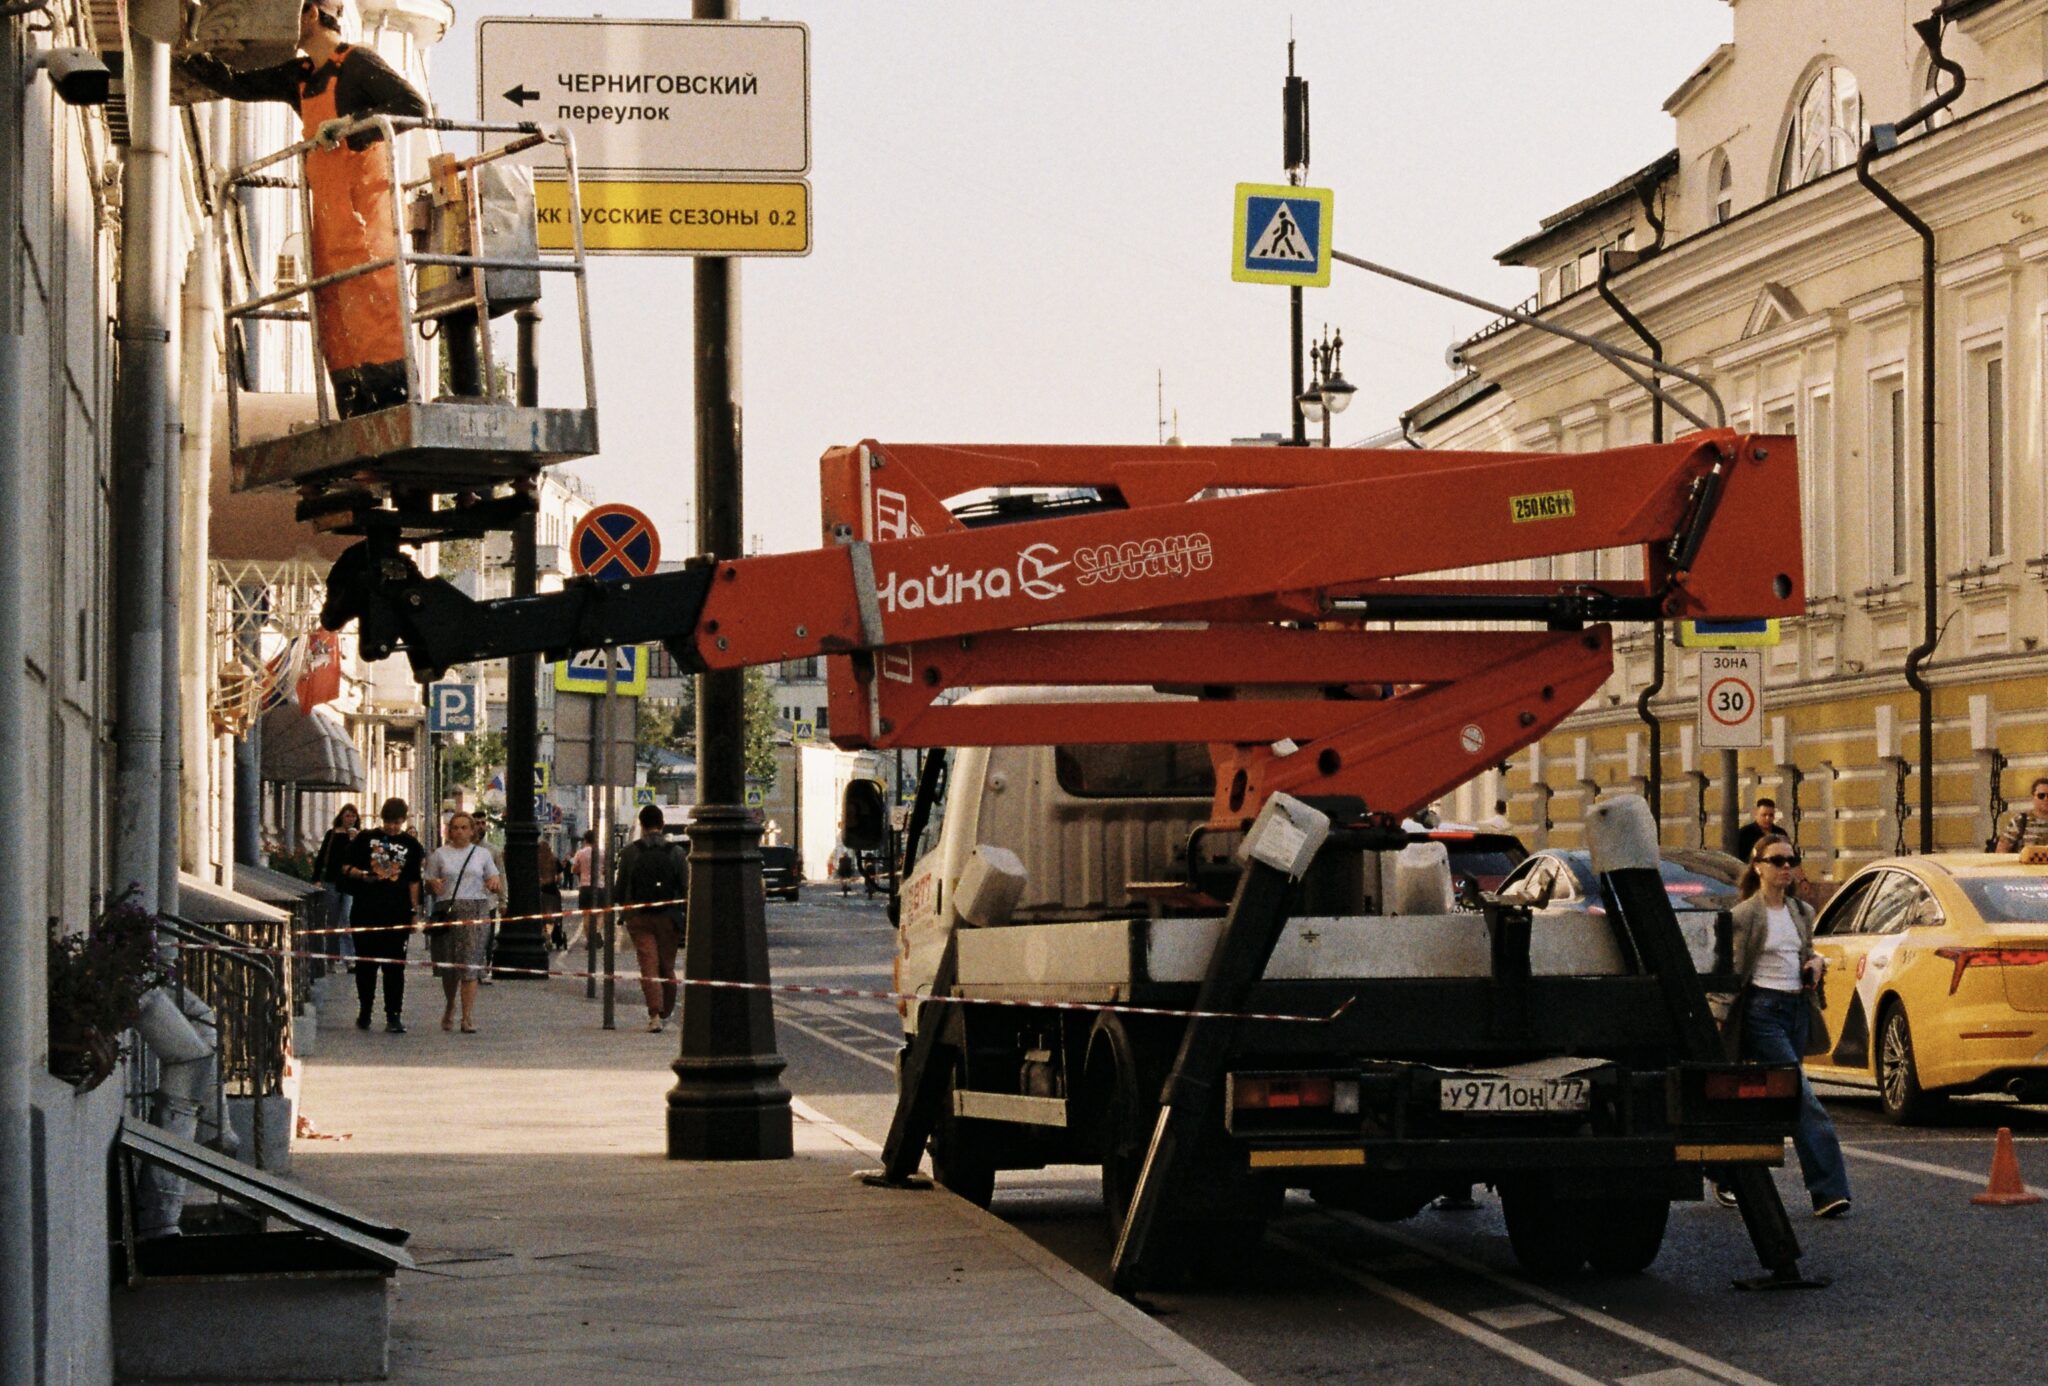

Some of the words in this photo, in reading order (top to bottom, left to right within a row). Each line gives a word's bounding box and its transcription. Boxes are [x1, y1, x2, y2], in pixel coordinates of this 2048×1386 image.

[557, 73, 758, 95] ЧЕРНИГОВСКИЙ
[558, 104, 670, 125] переулок
[567, 207, 663, 225] УССКИЕ
[669, 208, 759, 226] СЕЗОНЫ
[768, 209, 797, 226] 0.2
[1713, 657, 1748, 669] ЗОНА
[440, 688, 467, 728] P
[1718, 692, 1745, 711] 30
